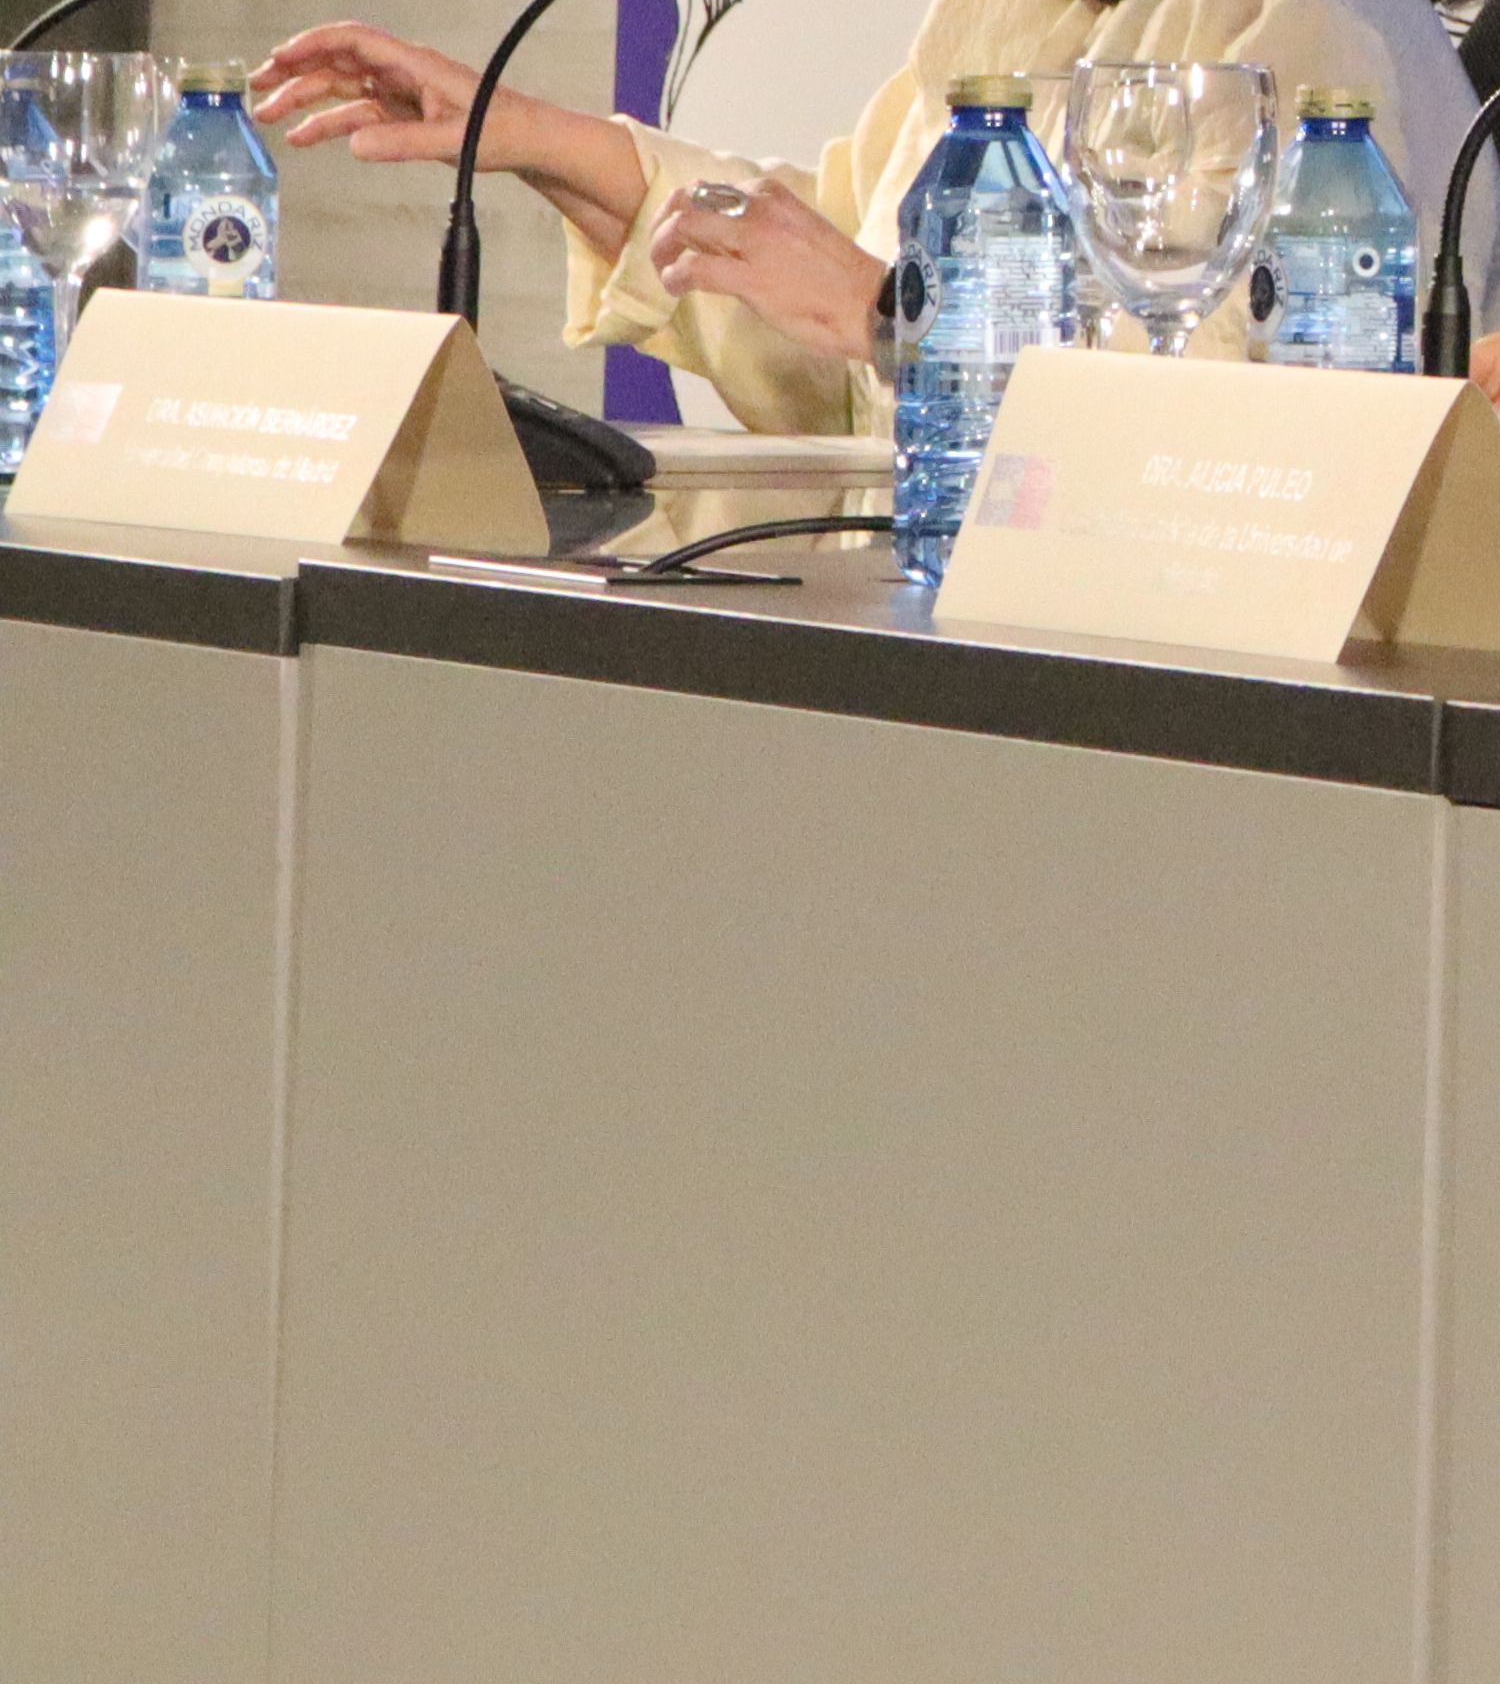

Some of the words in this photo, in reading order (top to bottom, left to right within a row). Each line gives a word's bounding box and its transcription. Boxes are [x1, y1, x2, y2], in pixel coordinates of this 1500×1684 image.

[188, 202, 262, 251] MONDARIZ
[1185, 459, 1249, 494] ALICIA
[1247, 464, 1313, 501] PULEO
